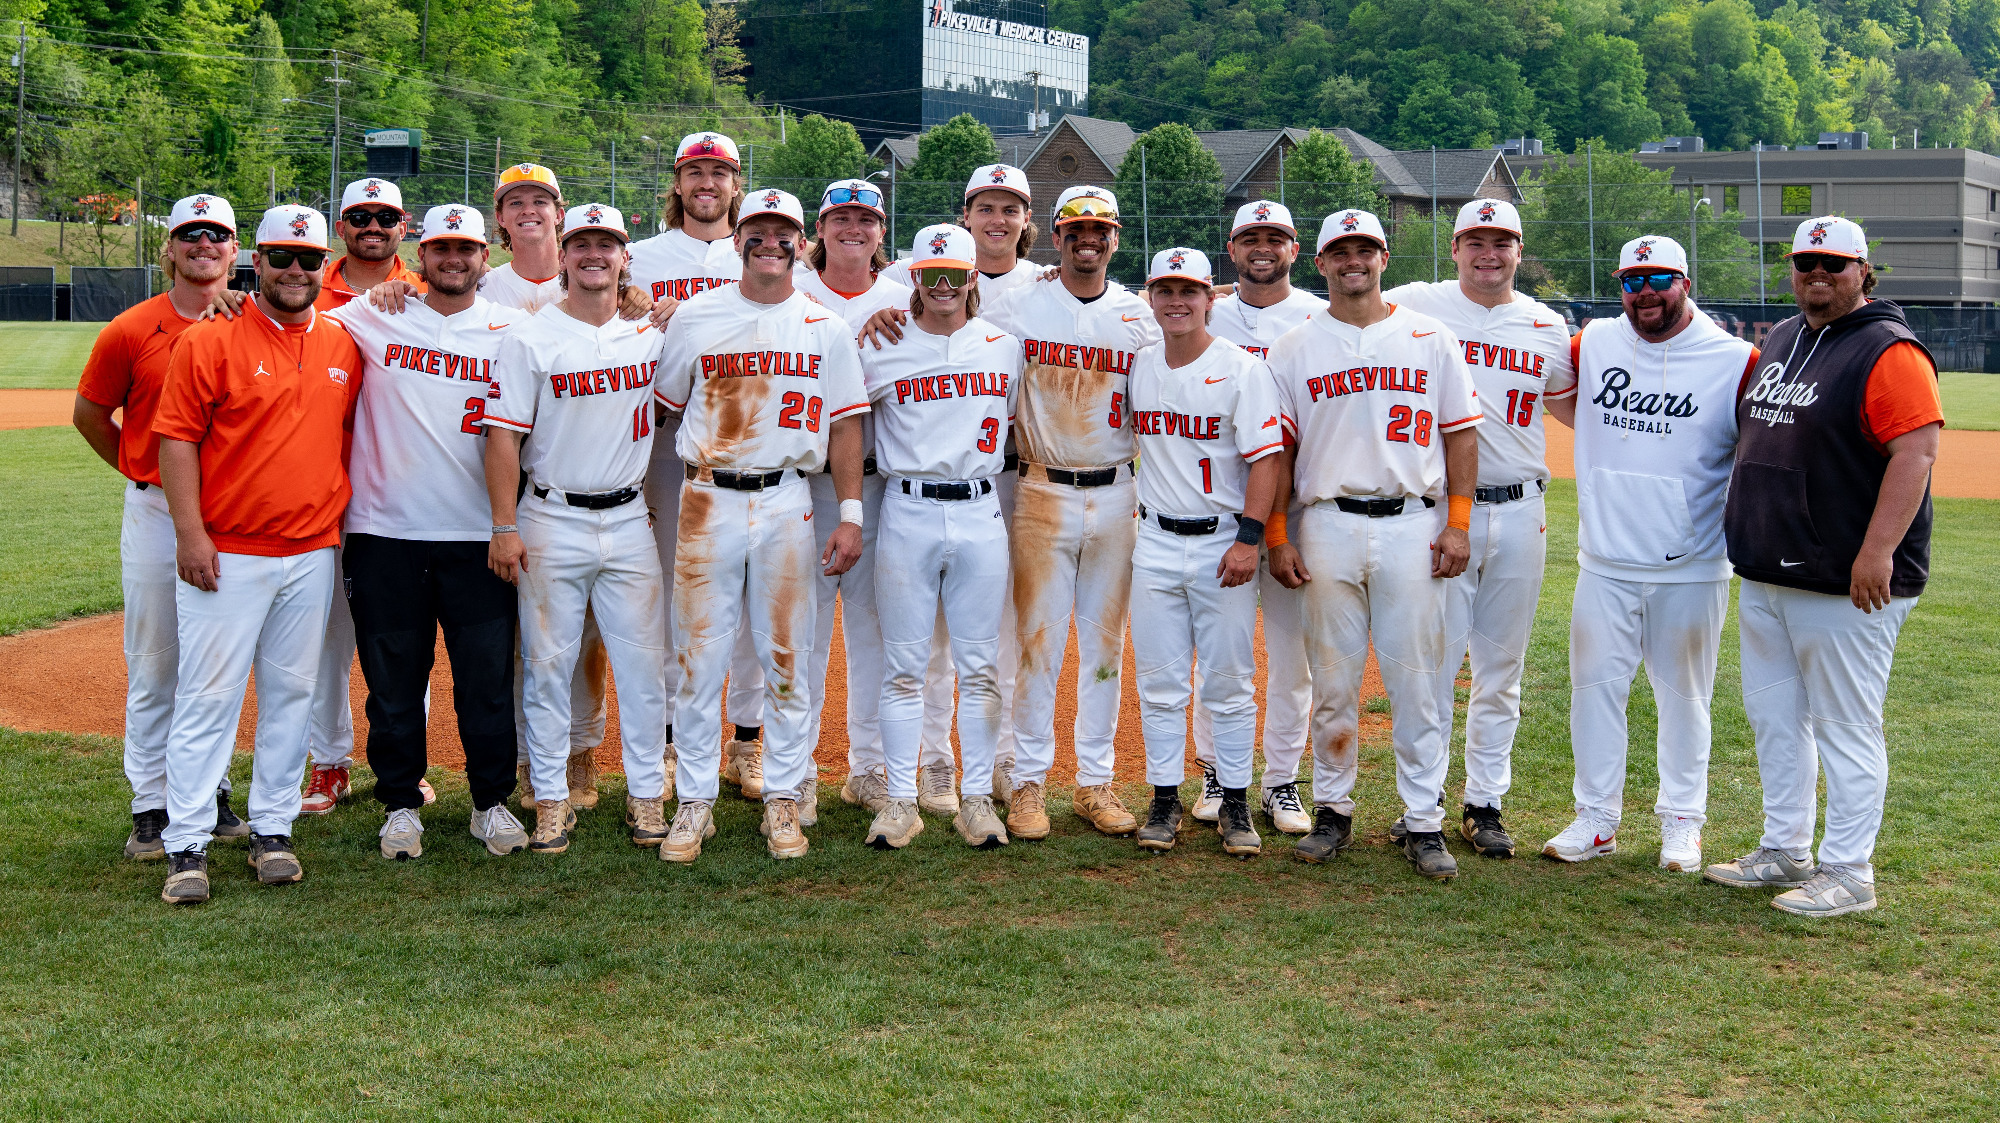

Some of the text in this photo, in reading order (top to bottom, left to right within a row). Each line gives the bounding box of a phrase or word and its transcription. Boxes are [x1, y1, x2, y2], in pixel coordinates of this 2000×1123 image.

[940, 11, 1088, 50] PIKEVILLE MEDICAL CENTER
[385, 344, 497, 383] PIKEVILL
[701, 351, 822, 379] PIKEVILLE
[1459, 340, 1545, 378] EVILLE
[895, 372, 1008, 405] PIKEVILLE
[1307, 367, 1428, 402] PIKEVILLE
[1592, 367, 1698, 417] Bears
[1746, 362, 1818, 406] Bears
[778, 391, 823, 433] 29
[1108, 391, 1123, 428] 5
[1387, 405, 1433, 447] 28
[1506, 389, 1538, 427] 15
[1603, 413, 1672, 434] BASEBALL
[1750, 405, 1795, 424] BASEBALL
[977, 417, 999, 454] 3
[1199, 458, 1212, 494] 1
